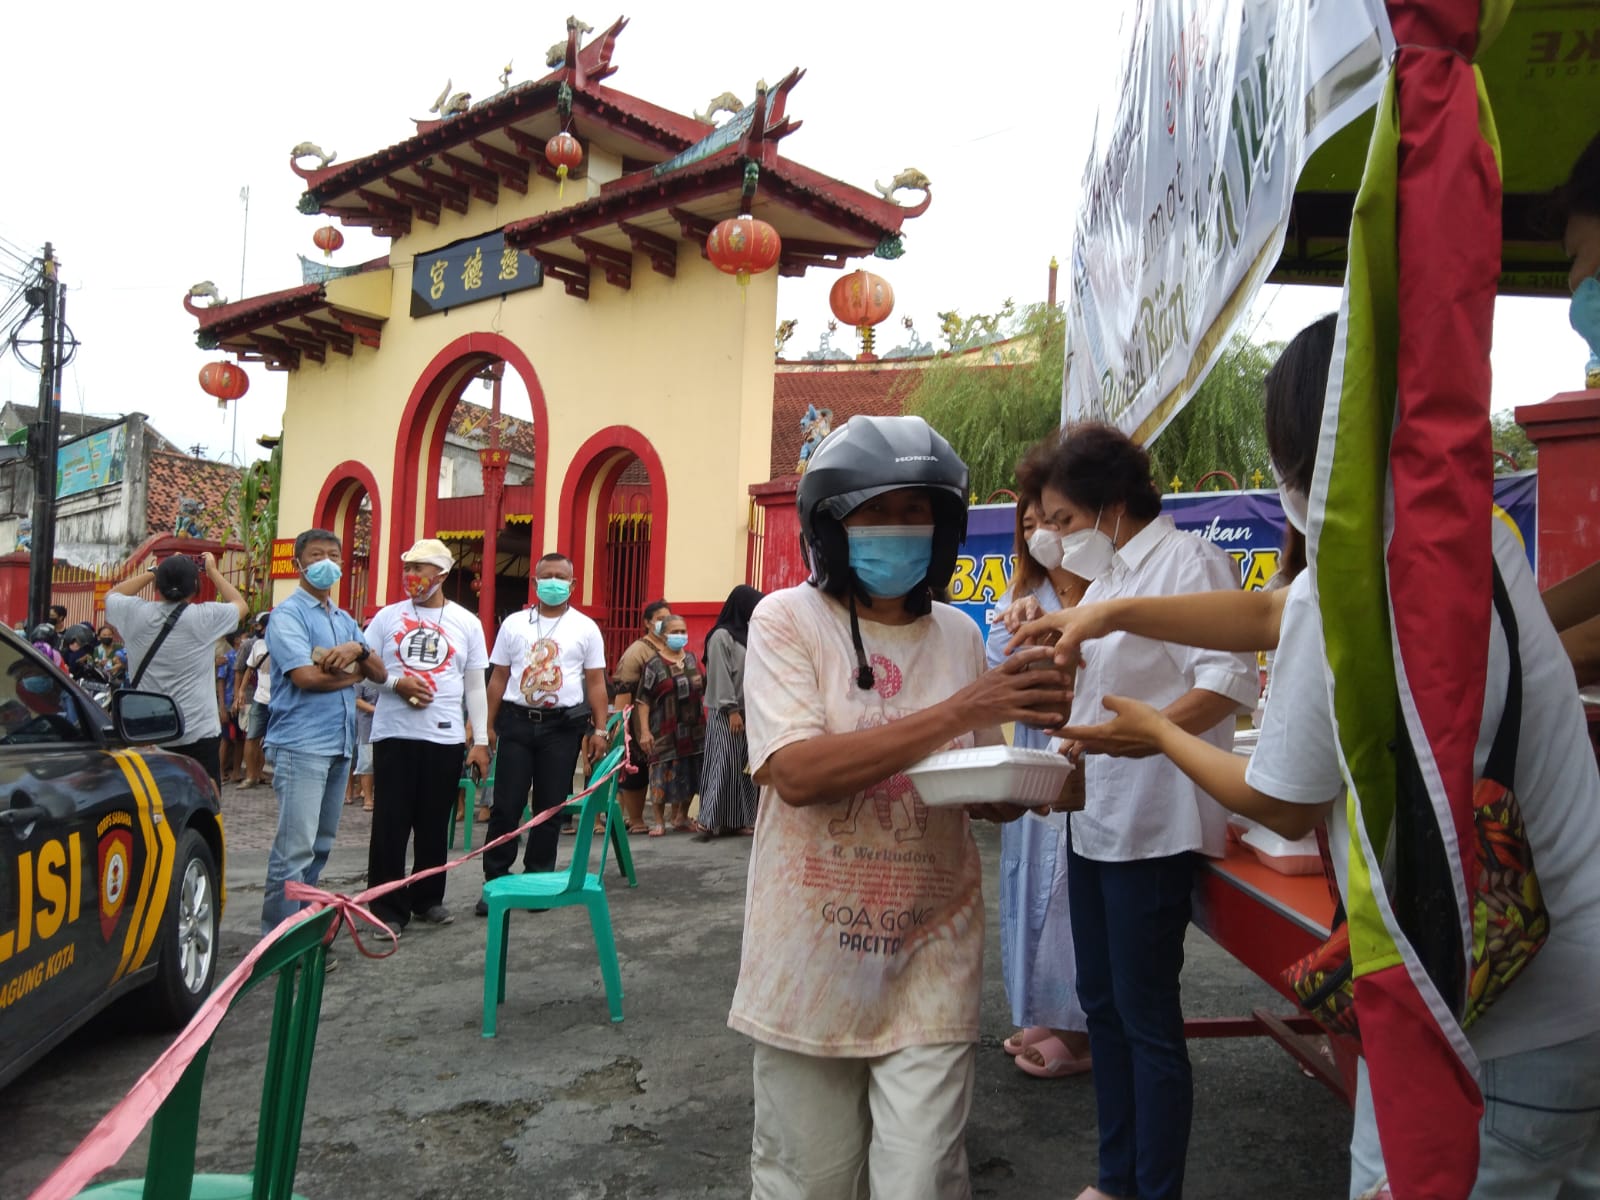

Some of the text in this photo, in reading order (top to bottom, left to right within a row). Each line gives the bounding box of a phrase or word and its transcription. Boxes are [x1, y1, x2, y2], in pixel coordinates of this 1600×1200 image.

[895, 455, 939, 463] HONDA
[822, 902, 872, 929] GOA
[45, 942, 75, 981] KOTA
